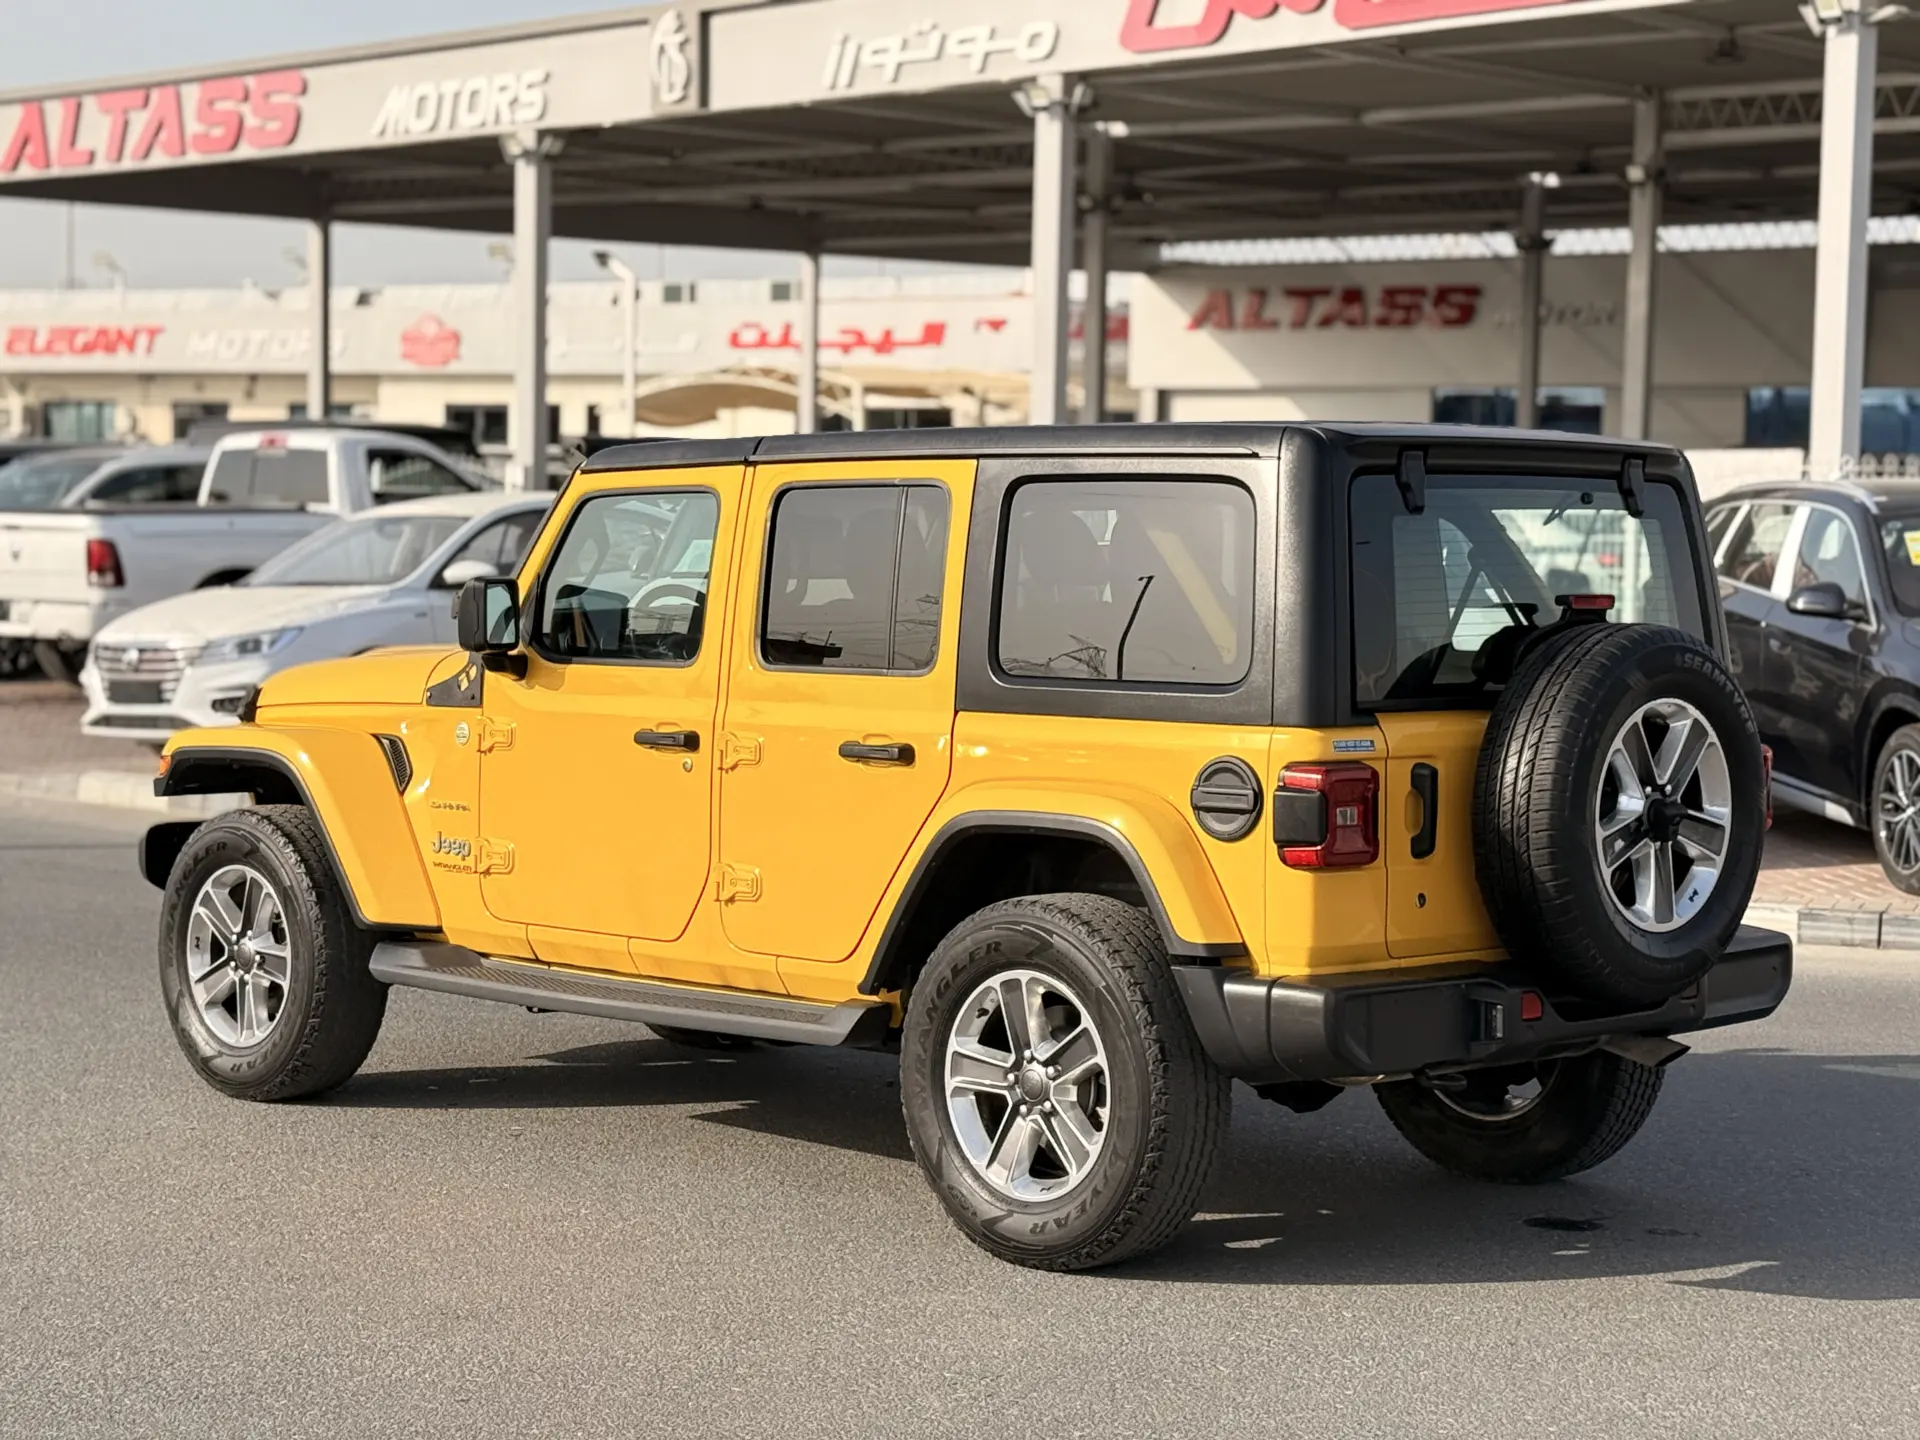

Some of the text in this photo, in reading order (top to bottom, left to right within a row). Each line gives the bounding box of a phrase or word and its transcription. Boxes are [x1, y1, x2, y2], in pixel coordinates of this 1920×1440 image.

[0, 69, 550, 172] ALTASS MOTORS
[1186, 285, 1482, 331] ALTASS
[4, 324, 165, 357] ELEGANT
[431, 831, 471, 861] Jeep
